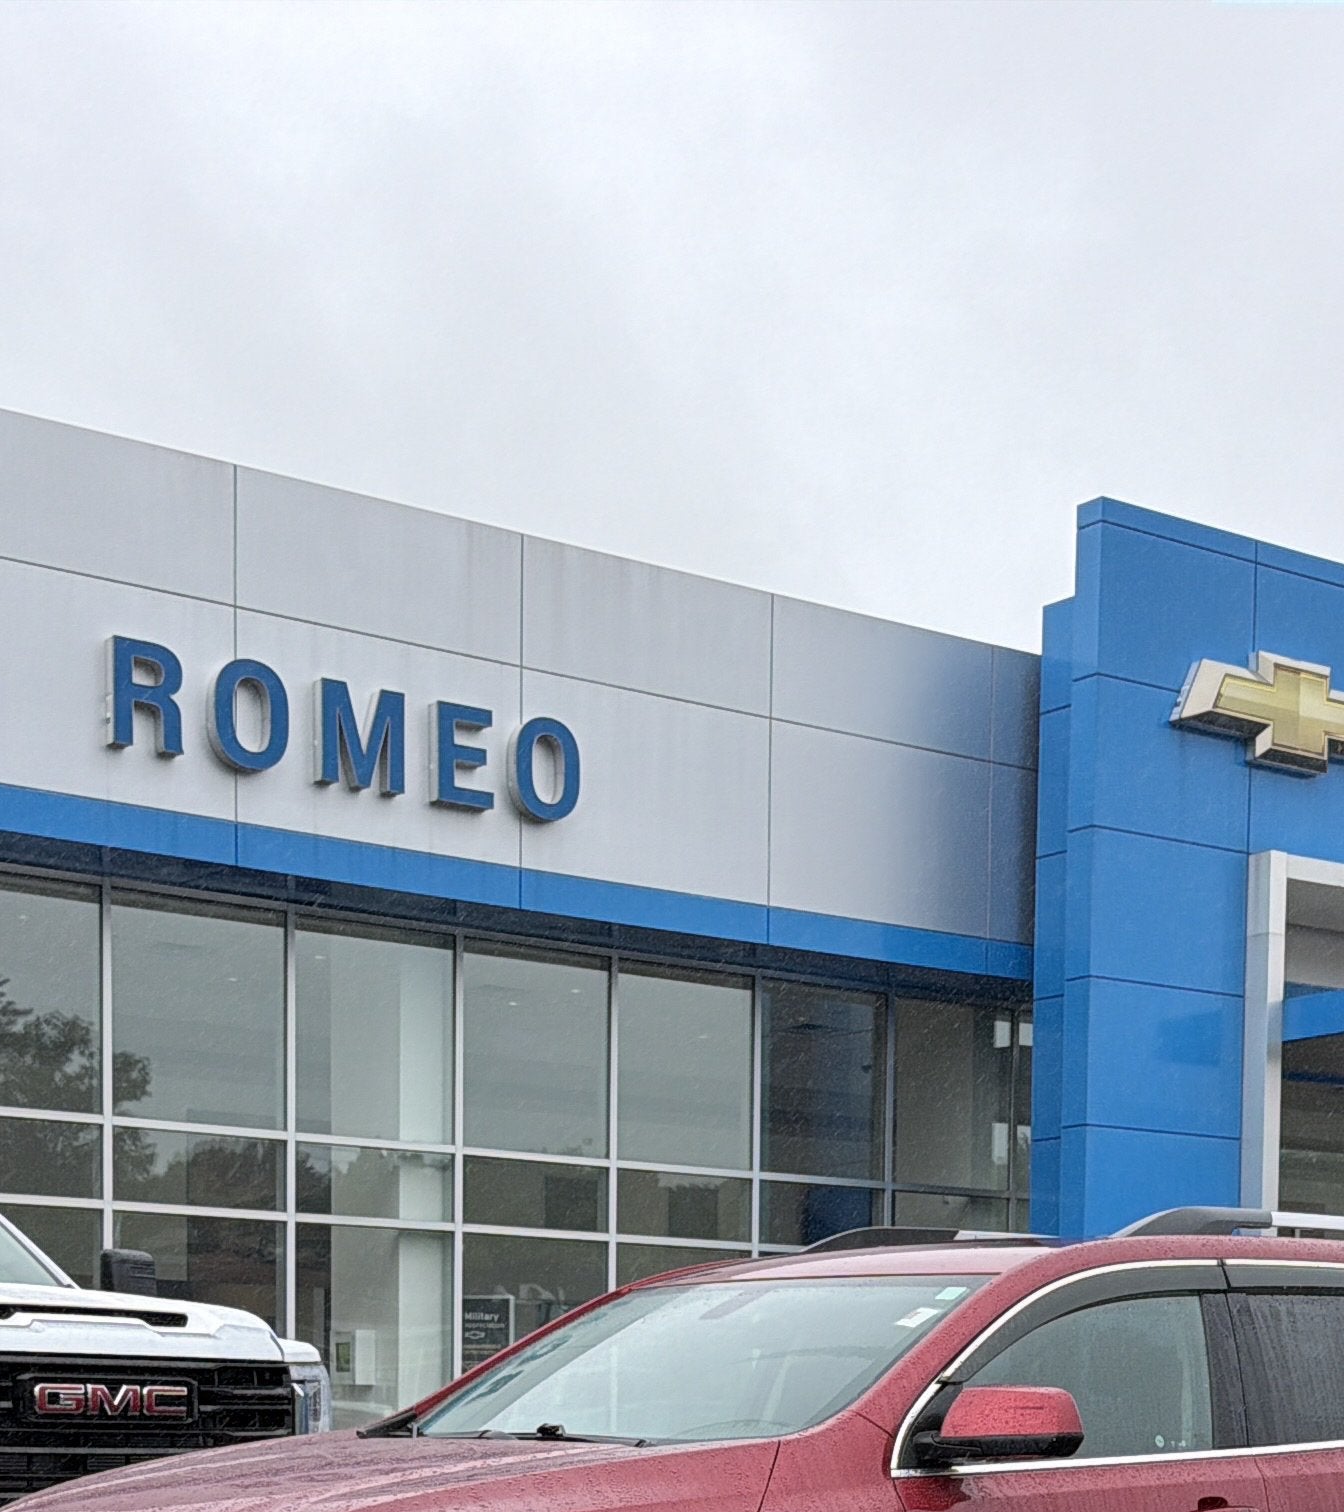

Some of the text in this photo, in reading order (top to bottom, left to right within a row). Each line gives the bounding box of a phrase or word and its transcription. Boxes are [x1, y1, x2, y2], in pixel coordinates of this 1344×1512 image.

[105, 635, 581, 823] ROMEO
[464, 1312, 500, 1323] Military
[34, 1383, 188, 1416] GMC
